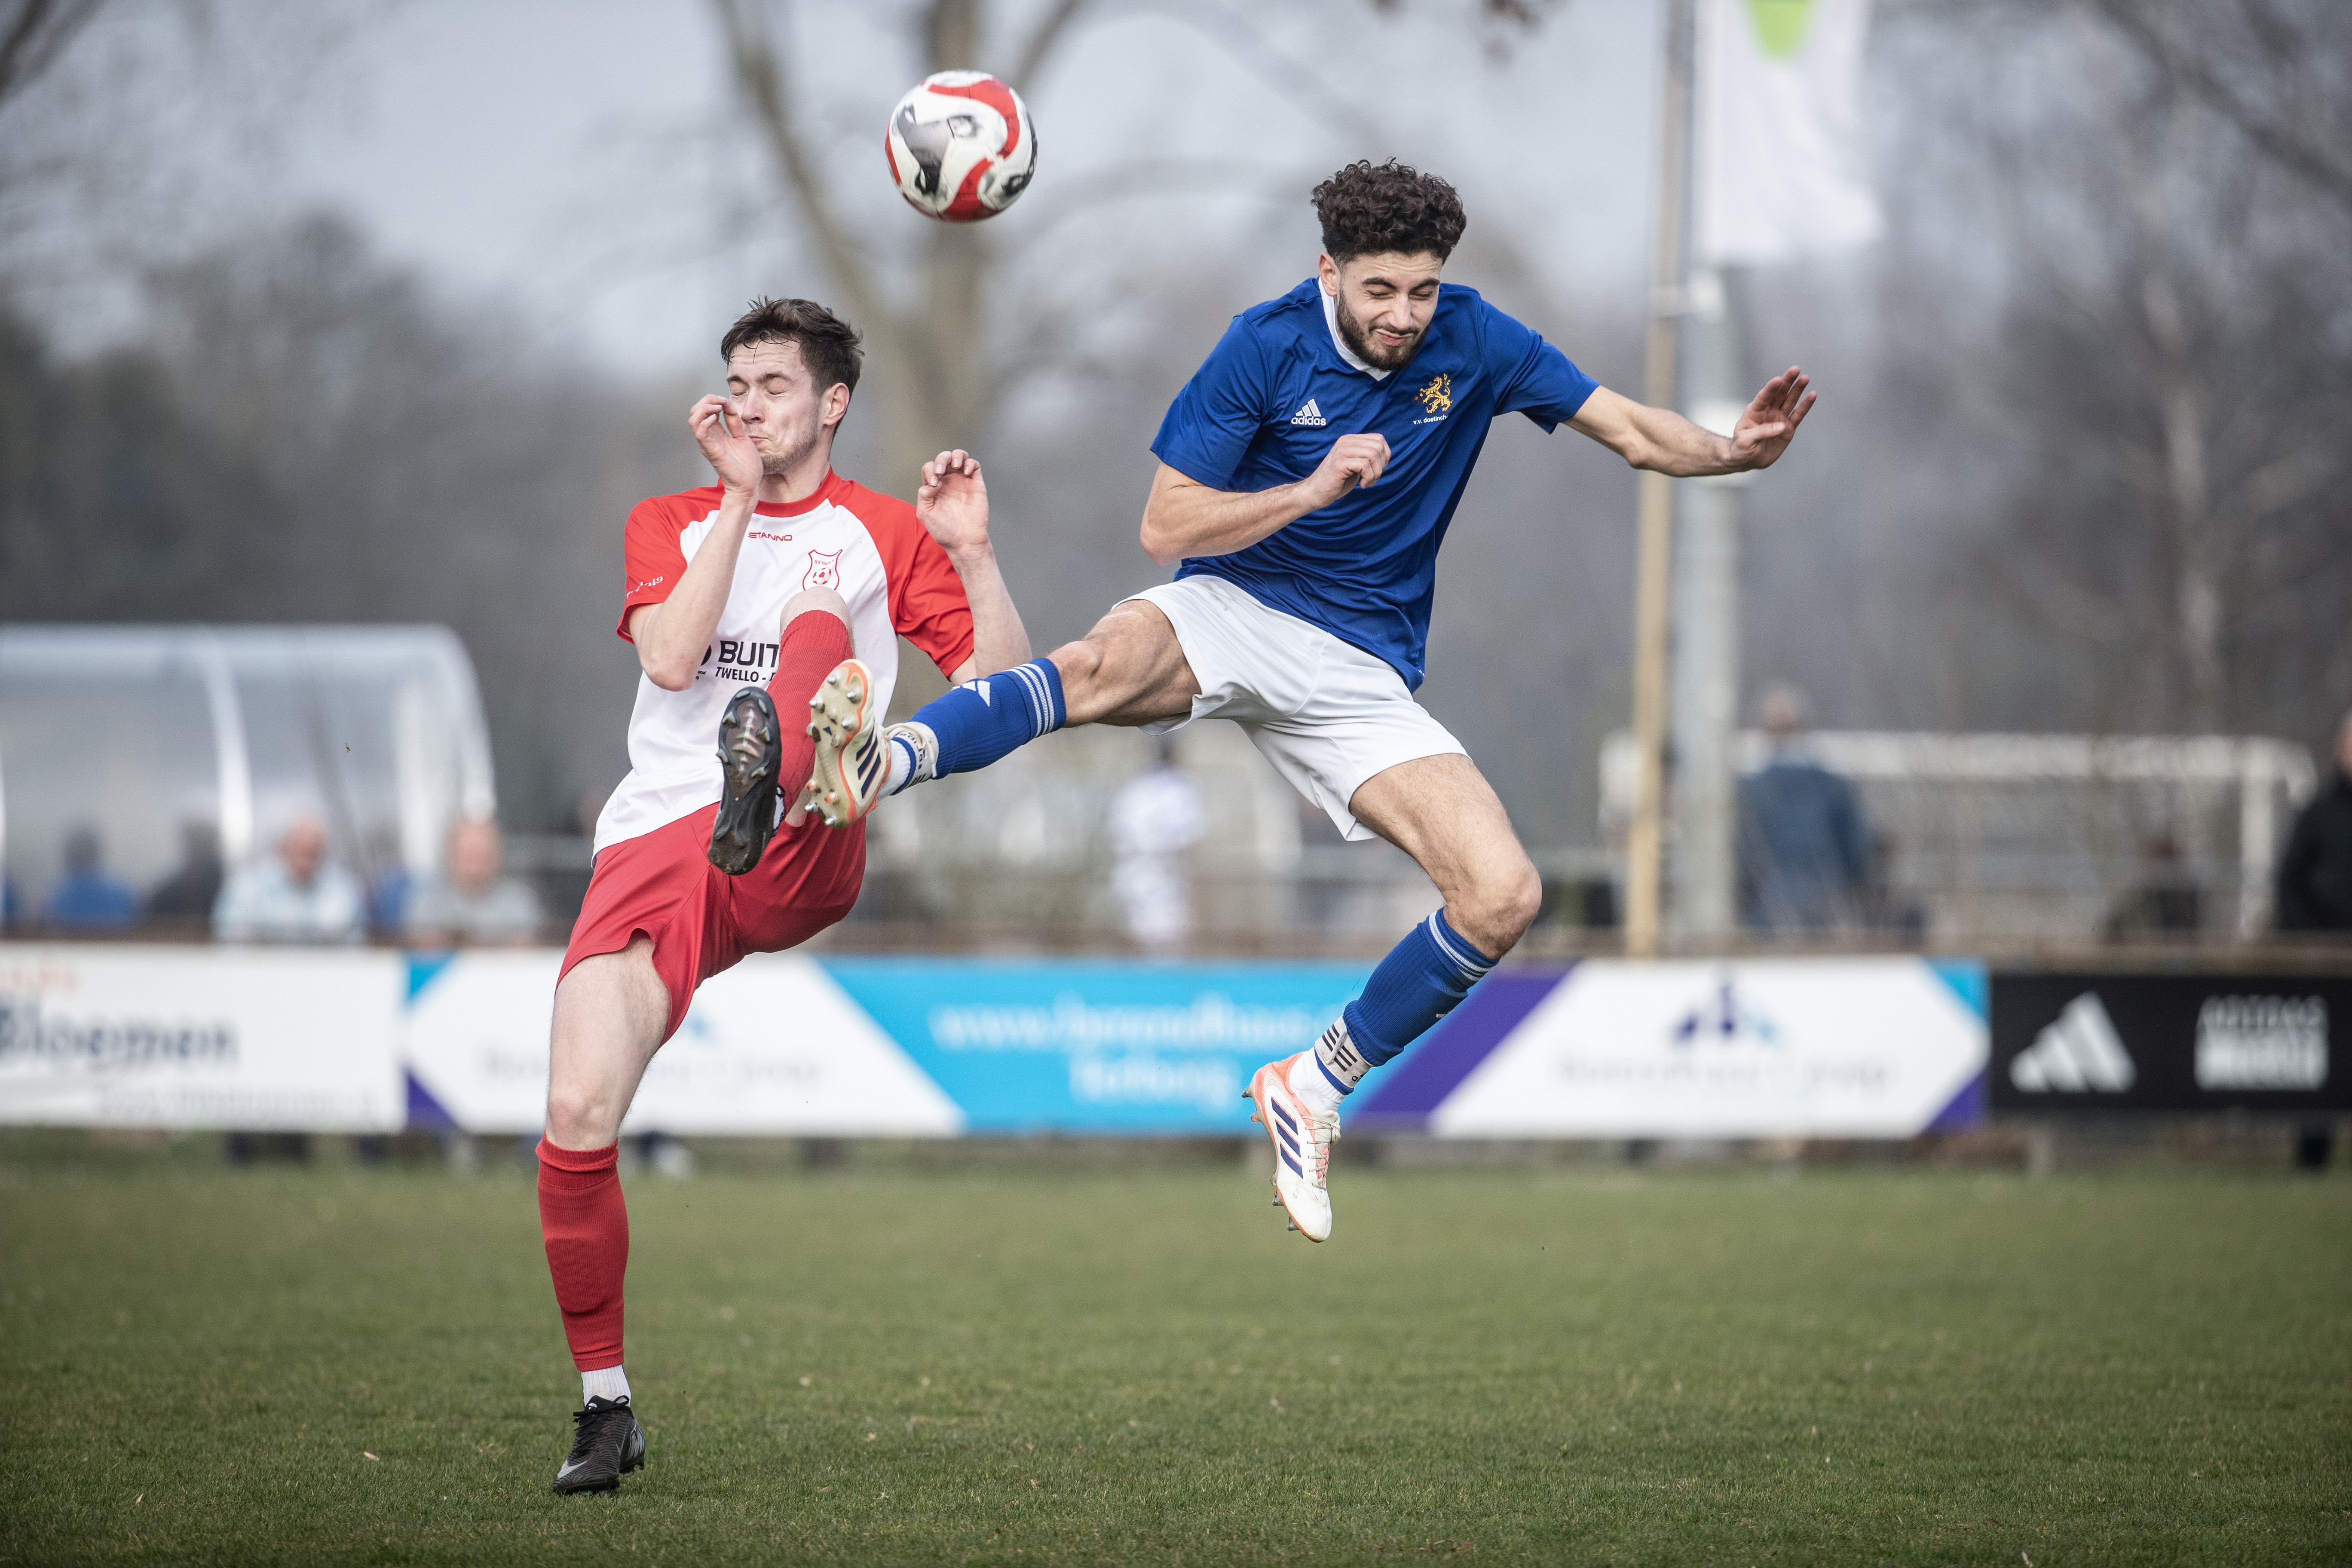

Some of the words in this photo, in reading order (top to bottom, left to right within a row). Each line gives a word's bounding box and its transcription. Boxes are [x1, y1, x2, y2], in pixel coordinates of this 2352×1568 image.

[1291, 415, 1326, 426] adidas
[748, 532, 792, 541] STANNO
[718, 640, 779, 668] BUIT
[715, 666, 759, 683] TWELLO
